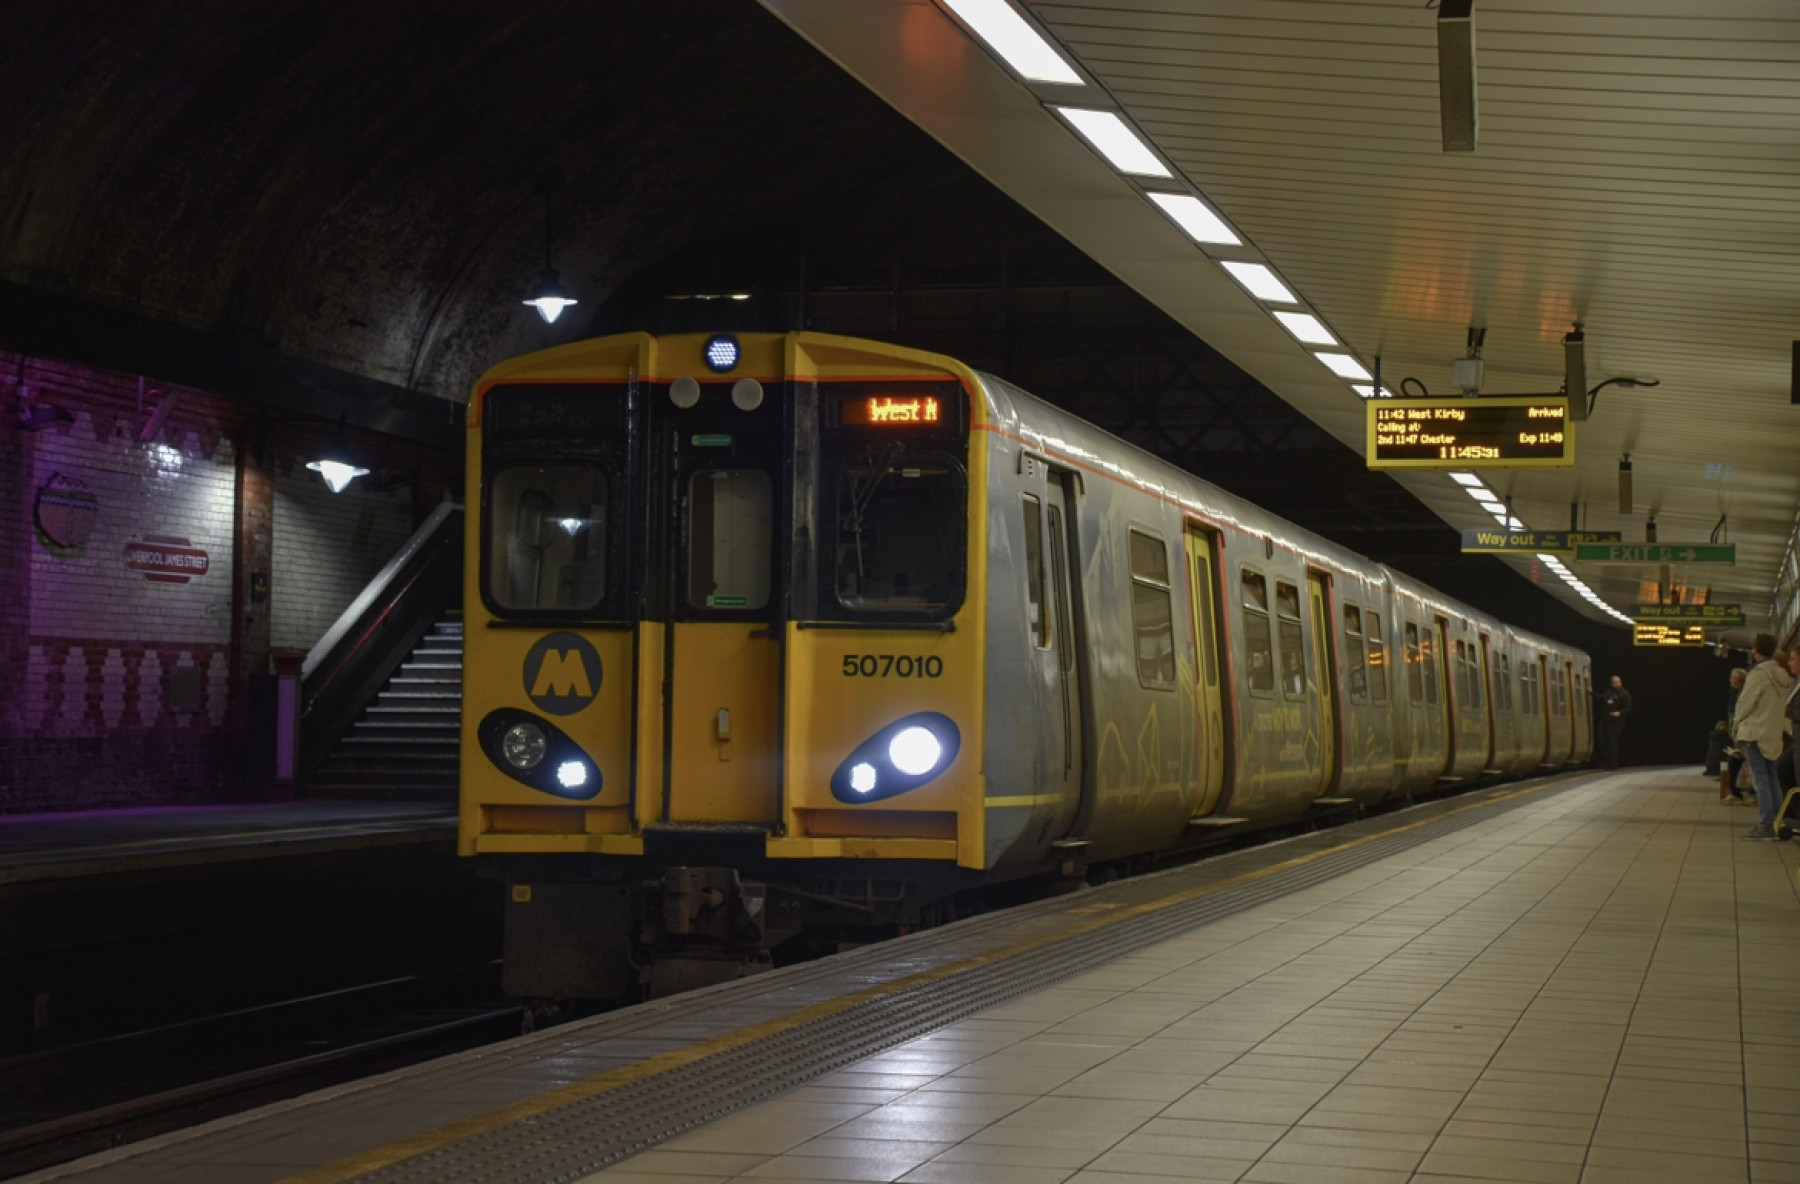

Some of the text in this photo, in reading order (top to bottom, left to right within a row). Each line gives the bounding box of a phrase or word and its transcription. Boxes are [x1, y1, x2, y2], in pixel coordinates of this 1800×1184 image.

[870, 397, 920, 421] West
[1378, 408, 1465, 421] 11:42 West Kirby
[1528, 407, 1564, 418] Arrived
[1377, 422, 1406, 434] Calling
[1377, 434, 1393, 445] 2nd
[1420, 433, 1456, 445] Chester
[1477, 533, 1507, 547] Way
[1510, 533, 1535, 546] out
[127, 549, 207, 569] LIVERPOOL JAMES STREET
[1610, 547, 1652, 560] EXIT
[1640, 606, 1661, 616] Way
[1663, 606, 1681, 615] out
[842, 654, 944, 678] 507010
